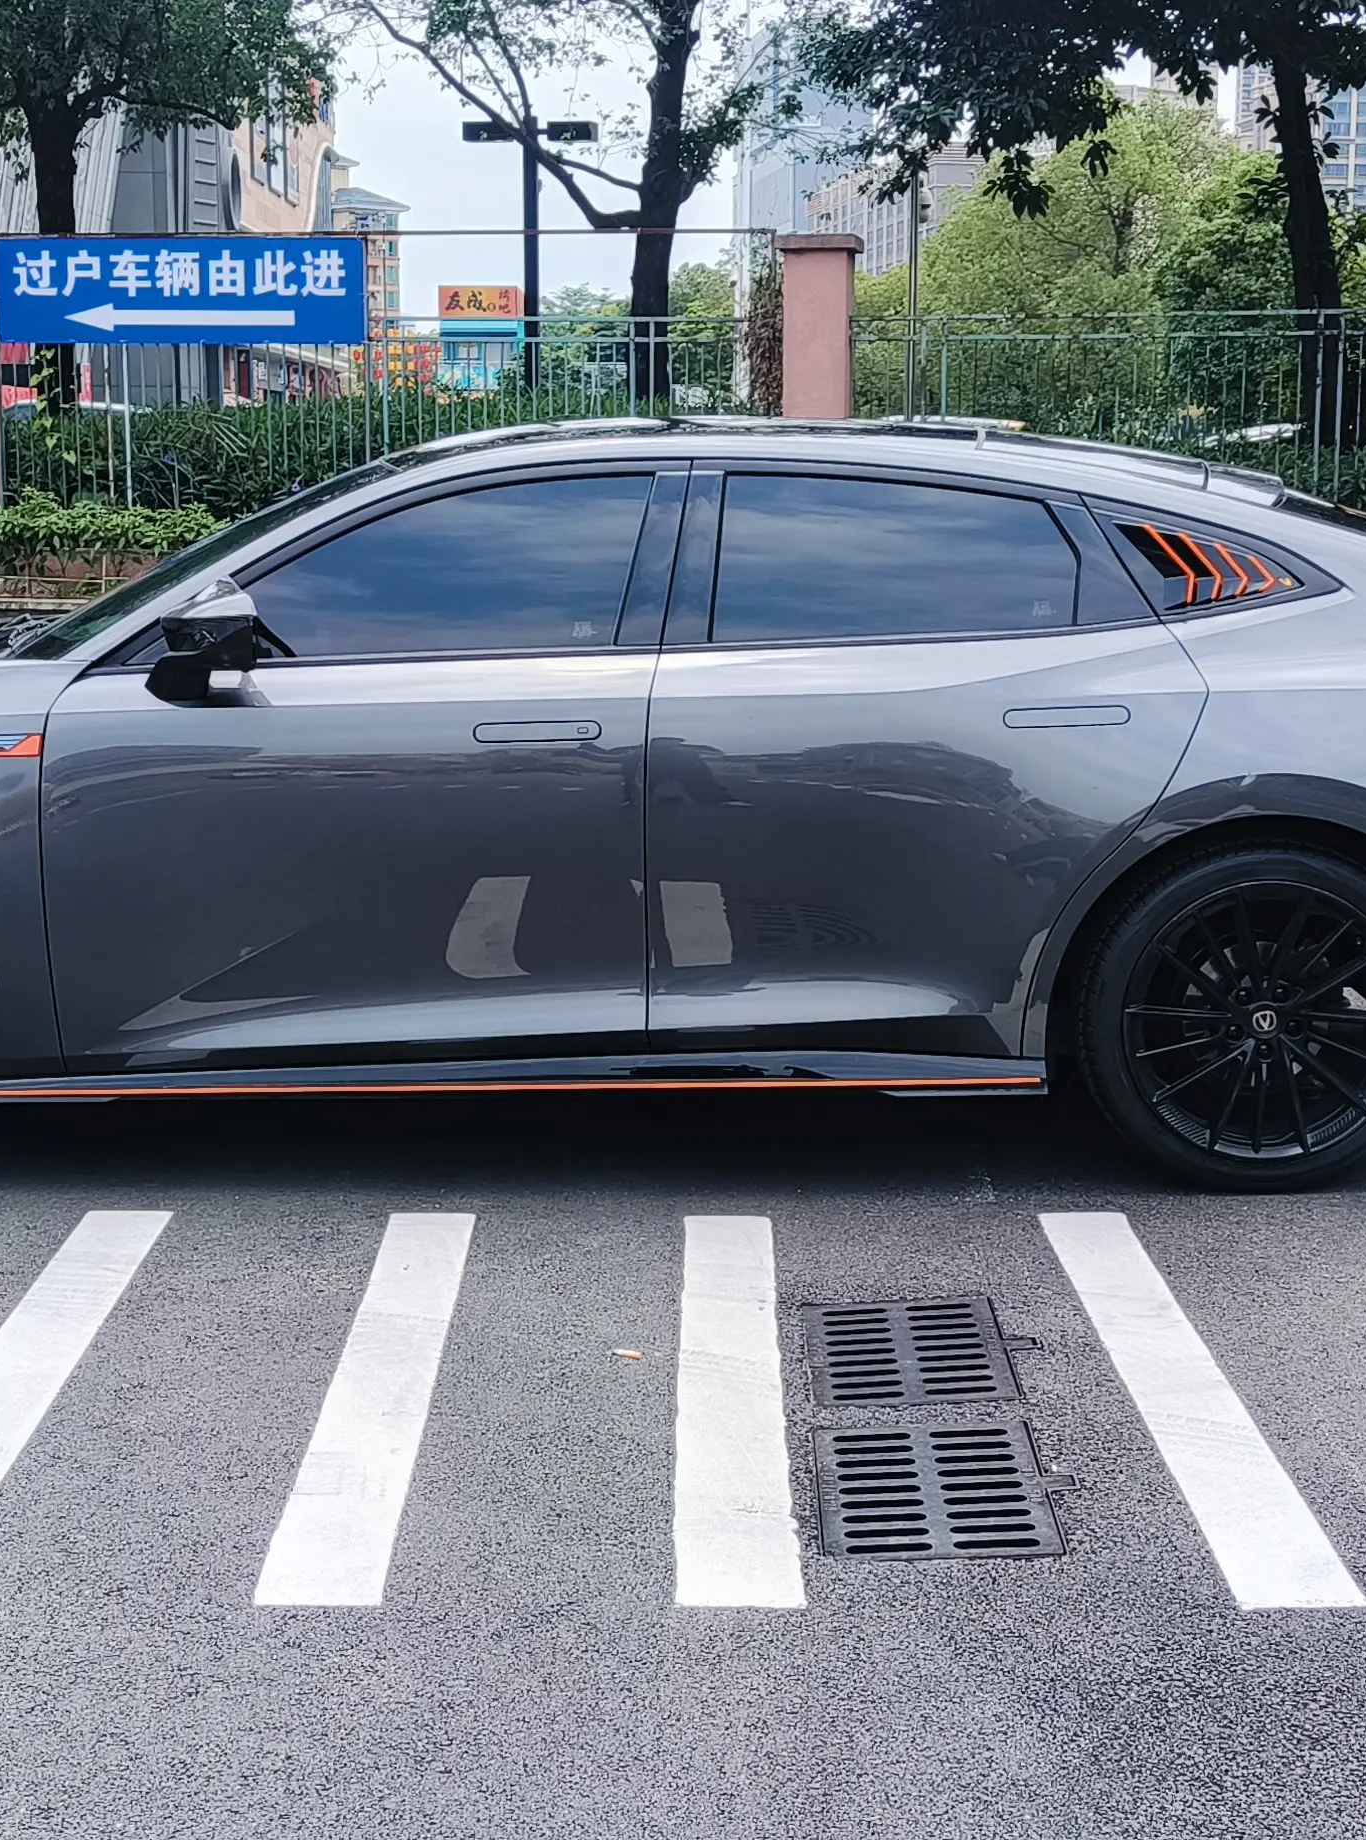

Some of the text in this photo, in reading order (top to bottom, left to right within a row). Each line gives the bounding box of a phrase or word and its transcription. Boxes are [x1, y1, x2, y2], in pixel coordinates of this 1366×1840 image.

[13, 249, 347, 297] 过户车辆由此进
